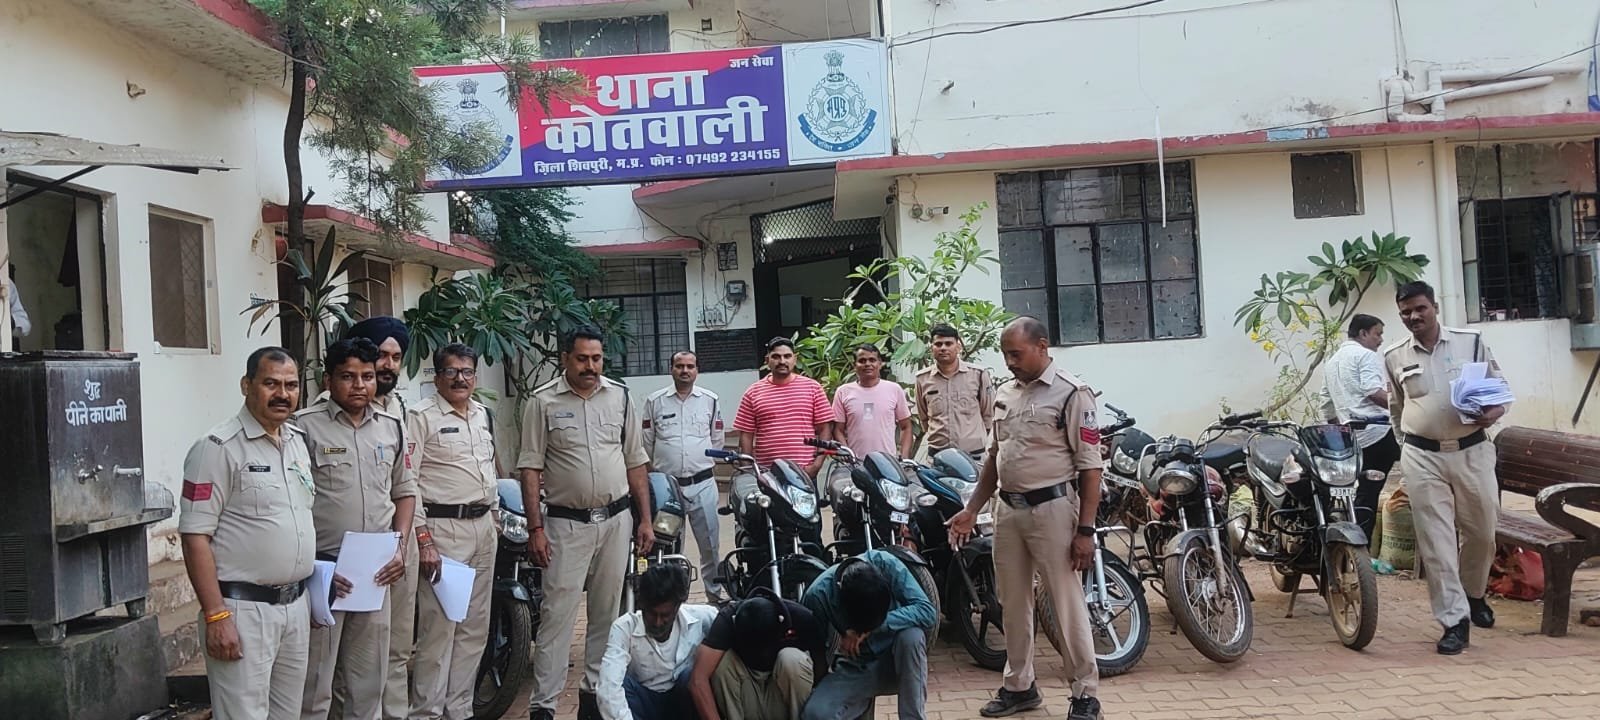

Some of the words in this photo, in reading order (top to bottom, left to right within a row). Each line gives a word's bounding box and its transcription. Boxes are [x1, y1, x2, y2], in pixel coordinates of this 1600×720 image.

[729, 58, 749, 68] जन
[752, 54, 774, 67] सेवा
[596, 69, 709, 110] थाना
[541, 95, 769, 154] कोतवाली
[567, 157, 613, 174] शिवपुरी,
[686, 152, 727, 167] 07492
[731, 148, 780, 162] 234155
